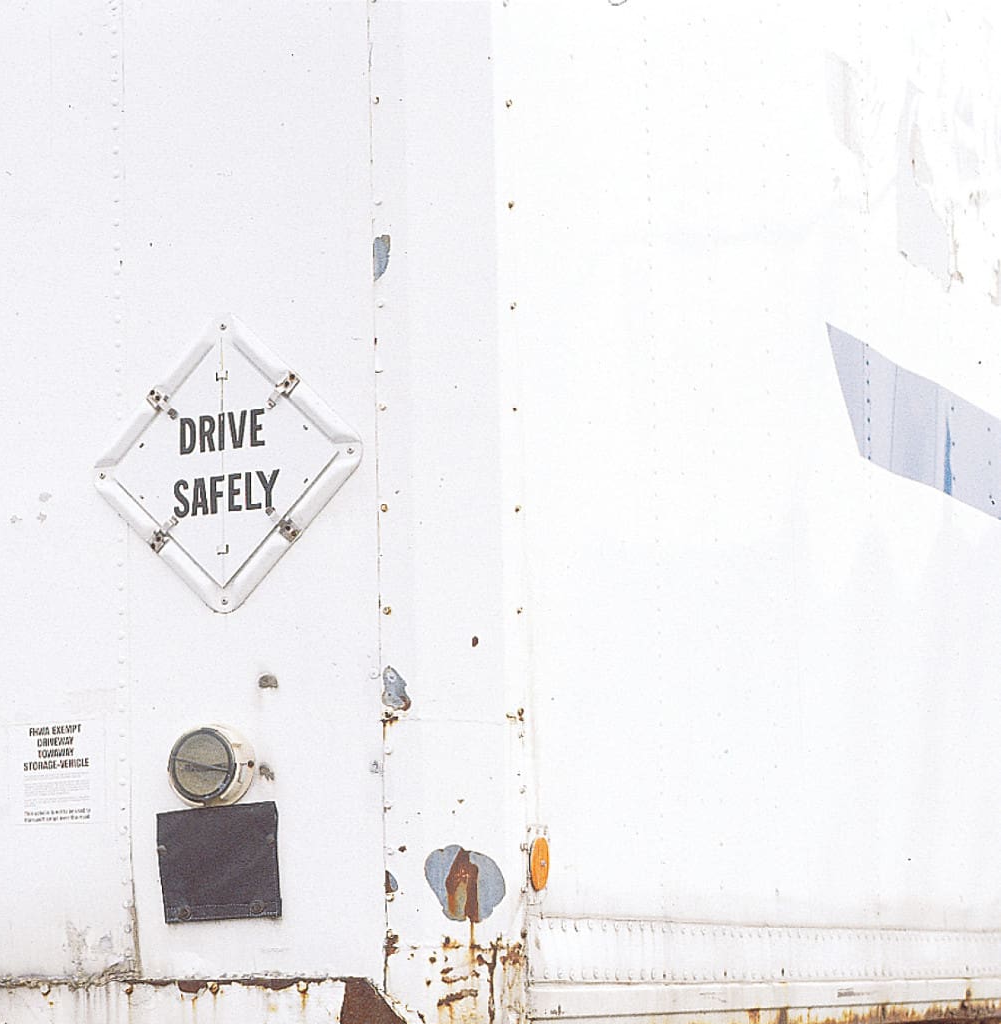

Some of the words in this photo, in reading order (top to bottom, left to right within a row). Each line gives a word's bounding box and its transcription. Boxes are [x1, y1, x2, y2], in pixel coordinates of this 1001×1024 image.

[179, 408, 265, 455] DRIVE
[173, 468, 280, 518] SAFELY
[52, 723, 82, 735] EXEMPT
[37, 736, 74, 747] DRIVEWAY
[37, 747, 75, 758] TOWAWAY
[23, 757, 90, 771] STORAGE-VEHICLE
